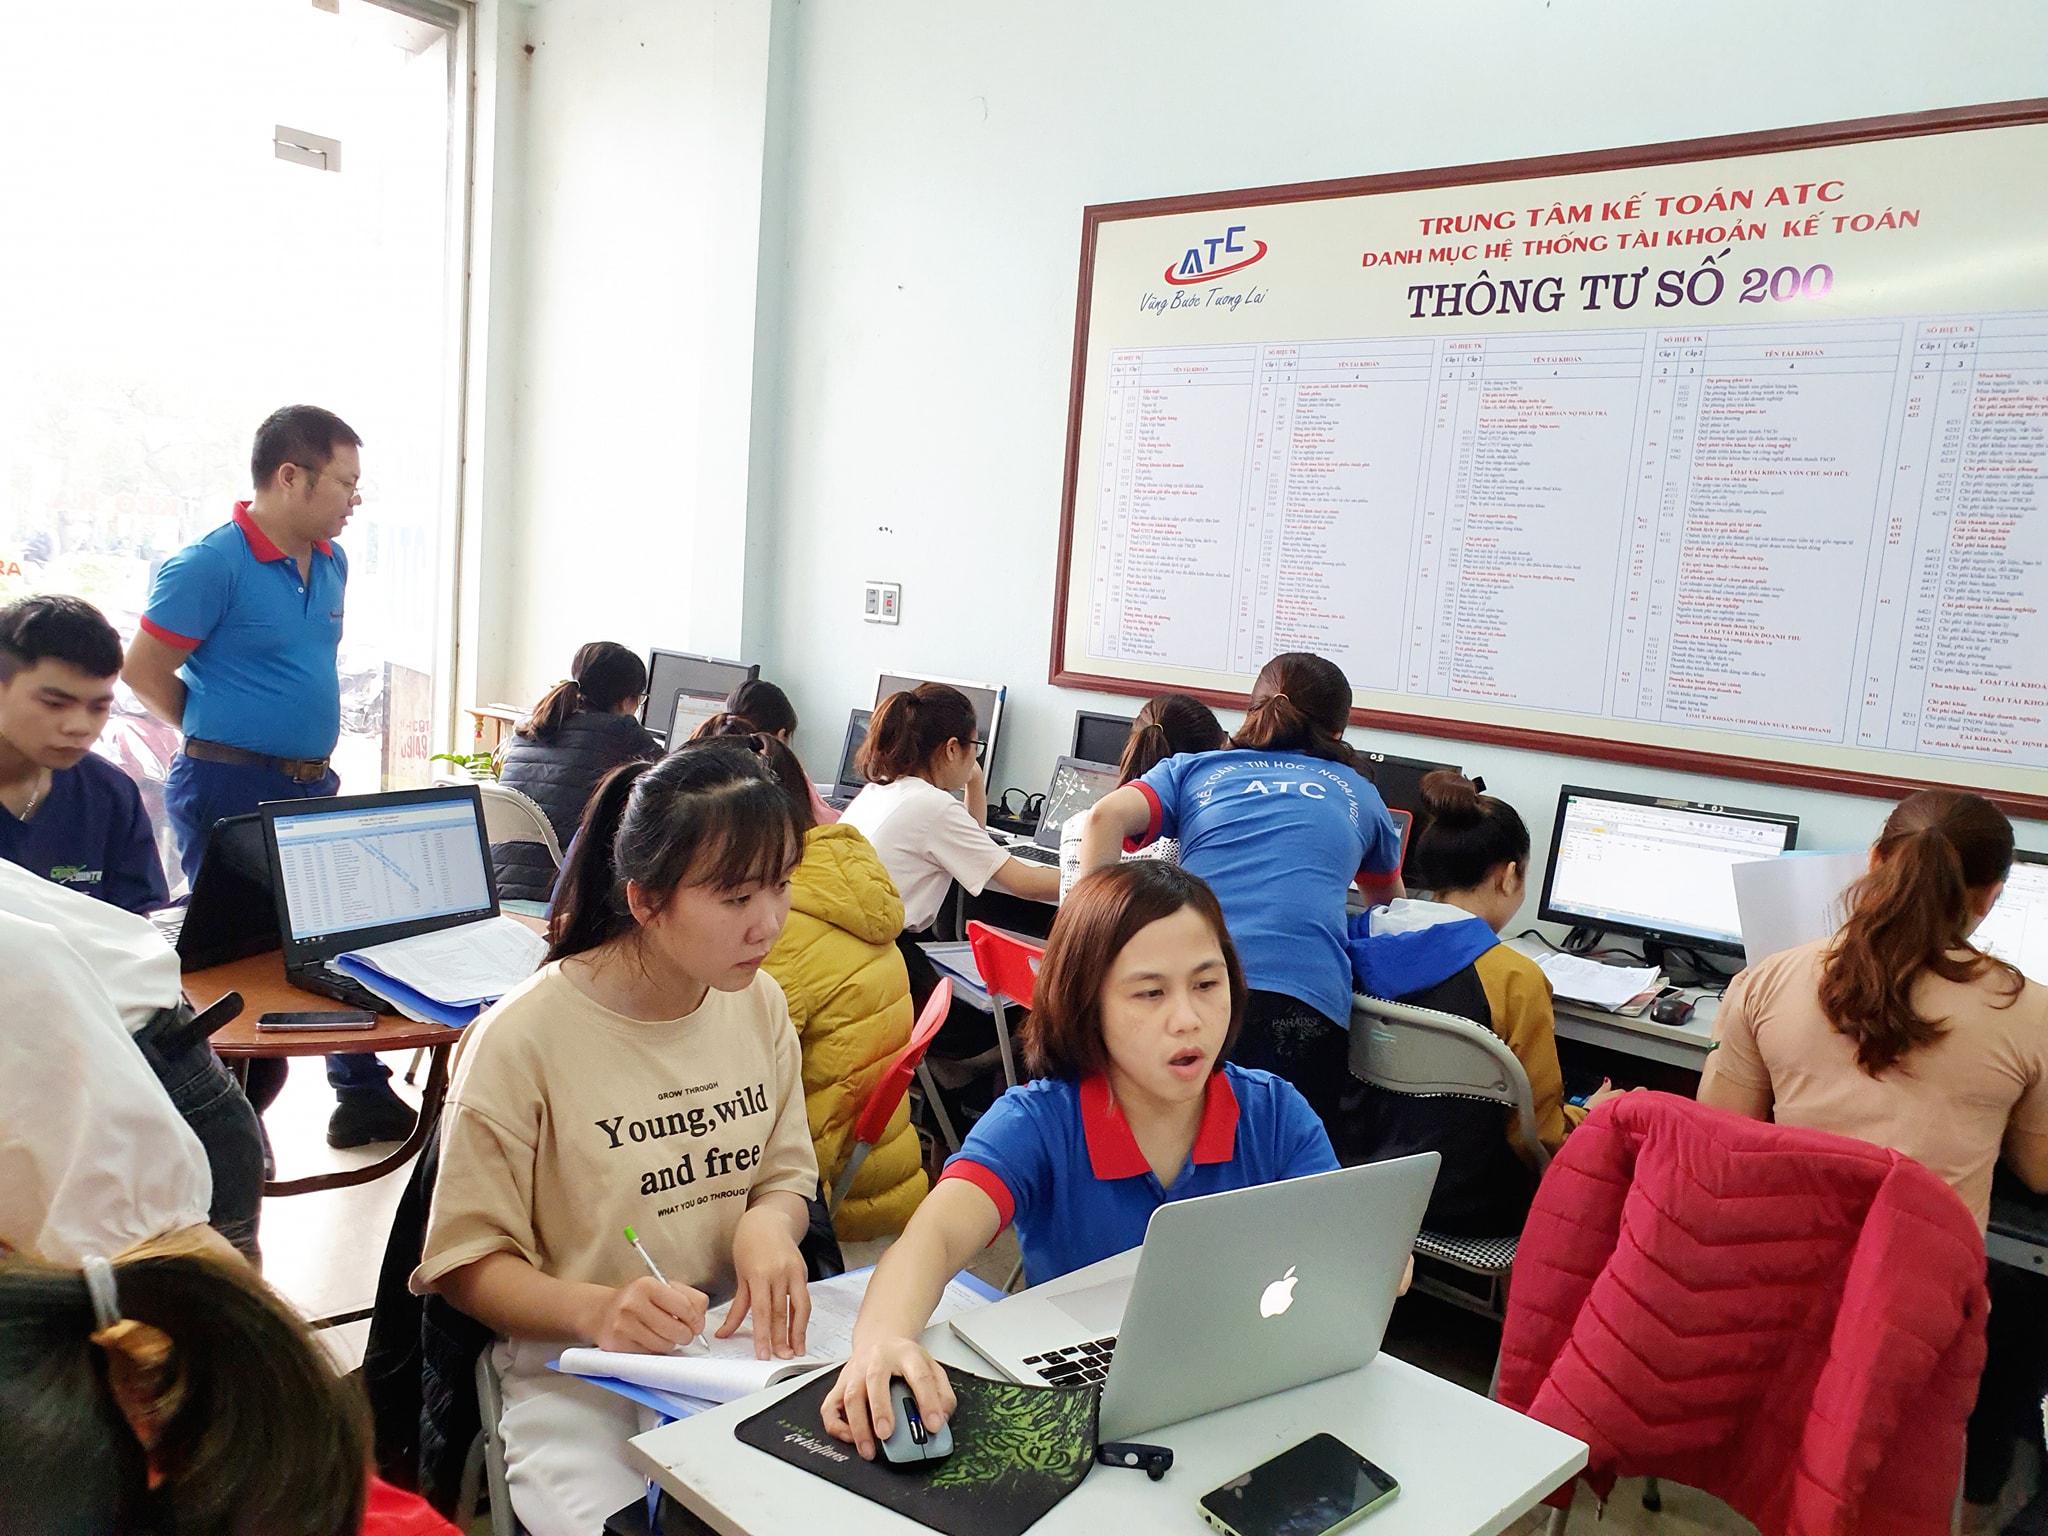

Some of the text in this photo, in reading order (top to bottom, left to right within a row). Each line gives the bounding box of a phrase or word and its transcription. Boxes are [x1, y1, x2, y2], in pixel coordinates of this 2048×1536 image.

[1419, 180, 1845, 236] TRUNG TÂM KẾ TOÁN ATC
[1179, 226, 1246, 275] ATC
[1362, 207, 1920, 267] DANH MỤC HỆ THỐNG TÀI KHOẢN KẾ TOÁN
[1244, 285, 1269, 304] Lai
[1407, 247, 1834, 318] THÔNG TƯ SỐ 200
[1242, 780, 1327, 800] ATC
[657, 1081, 719, 1101] GROW THROUGH
[640, 1144, 760, 1195] and free
[657, 1188, 749, 1217] WHAT YOU GO THROUG
